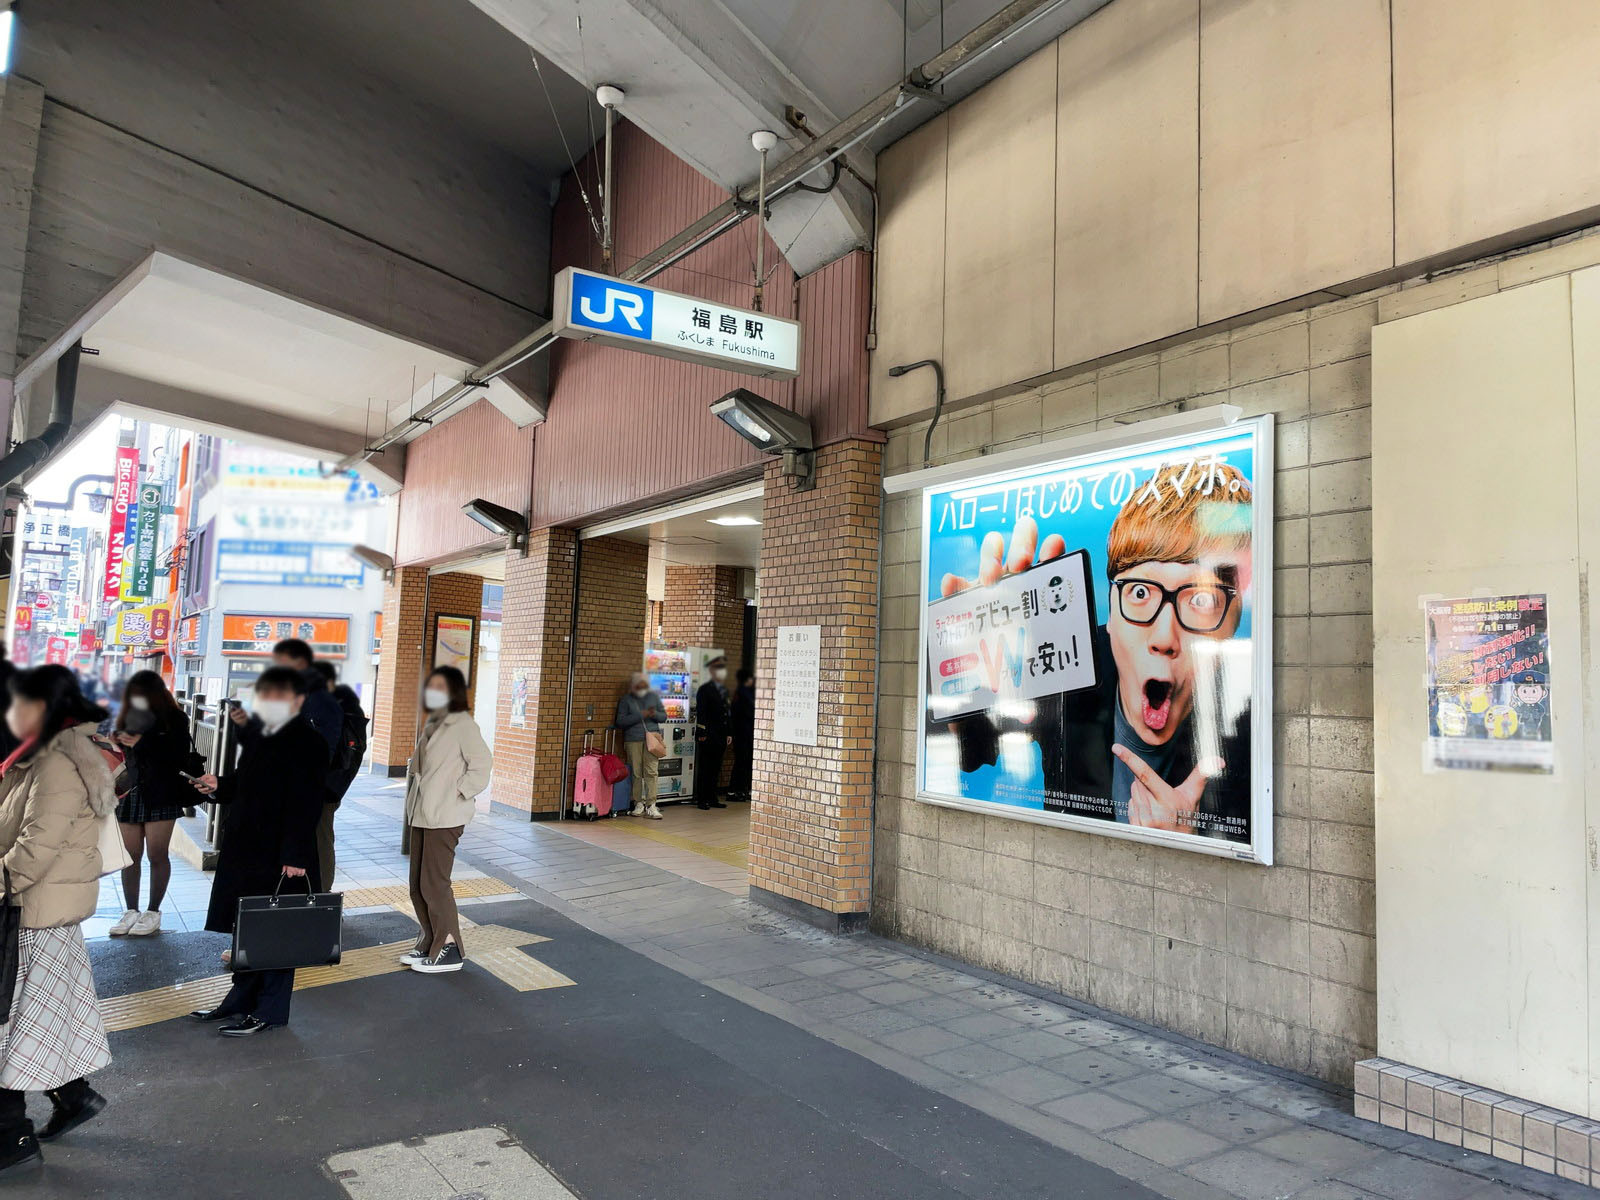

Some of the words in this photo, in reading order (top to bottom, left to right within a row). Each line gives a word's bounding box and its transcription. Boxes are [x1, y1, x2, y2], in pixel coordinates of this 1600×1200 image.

[580, 287, 644, 332] JR
[691, 306, 764, 341] 福島駅
[677, 330, 715, 347] ふくしま
[722, 340, 775, 361] Fukushima
[119, 457, 133, 481] BIG
[115, 481, 130, 514] ECHO
[788, 632, 809, 643] お願い
